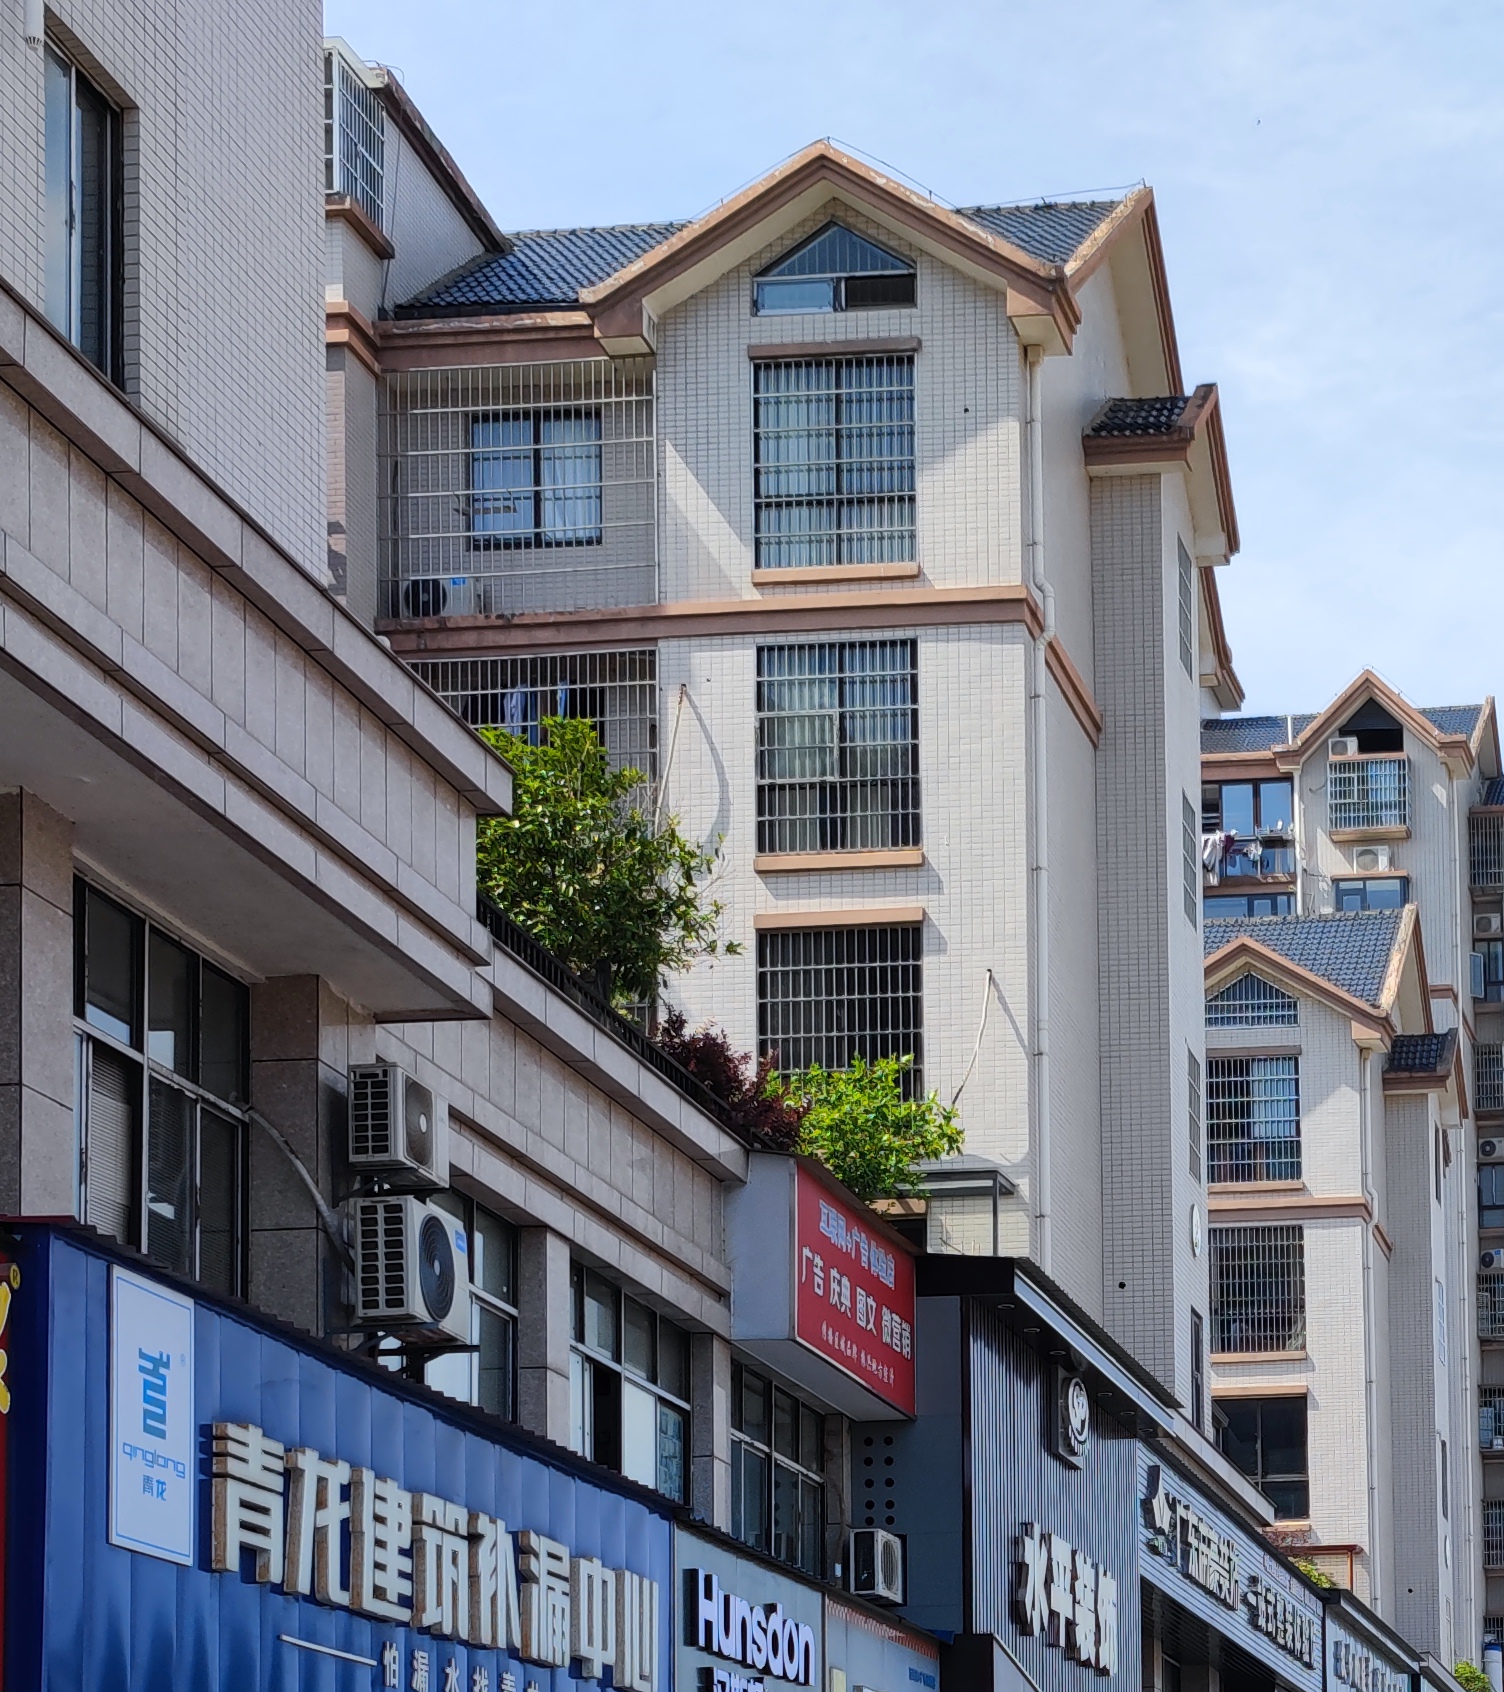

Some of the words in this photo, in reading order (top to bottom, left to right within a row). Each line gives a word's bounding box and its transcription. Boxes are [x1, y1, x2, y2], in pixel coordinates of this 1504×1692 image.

[802, 1247, 824, 1296] 广告
[830, 1267, 851, 1319] 庆典
[123, 1442, 186, 1480] qinglong
[142, 1474, 167, 1501] 青龙
[697, 1569, 816, 1686] Hunsdon
